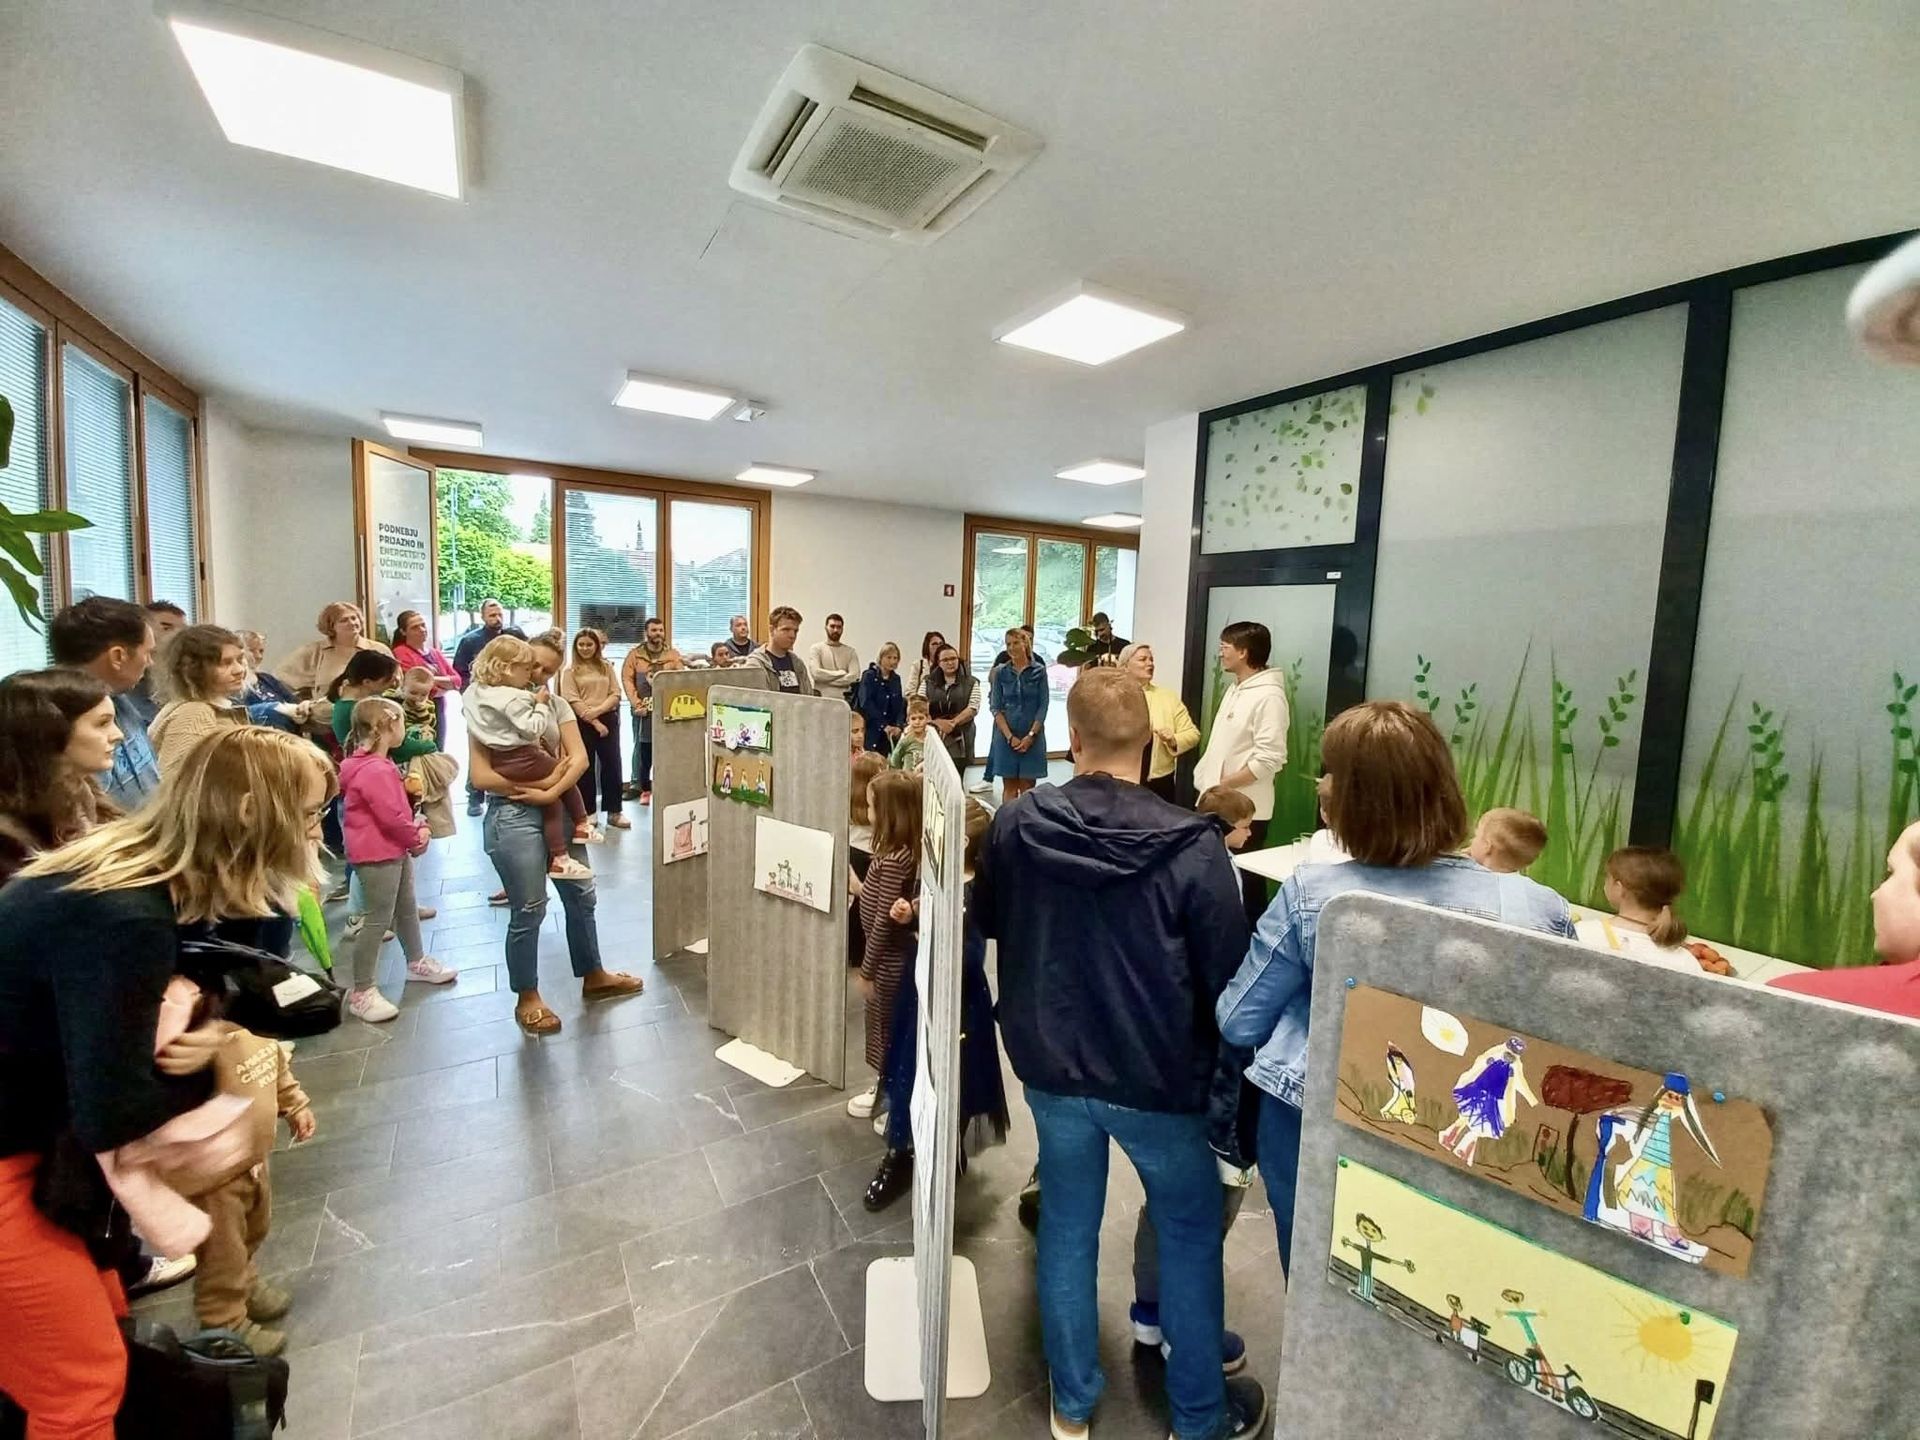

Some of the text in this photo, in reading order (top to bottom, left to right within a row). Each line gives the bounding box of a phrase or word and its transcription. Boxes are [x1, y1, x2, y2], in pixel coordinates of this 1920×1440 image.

[378, 523, 419, 537] PODNEBJU
[379, 535, 425, 549] PRIJAZNO IN
